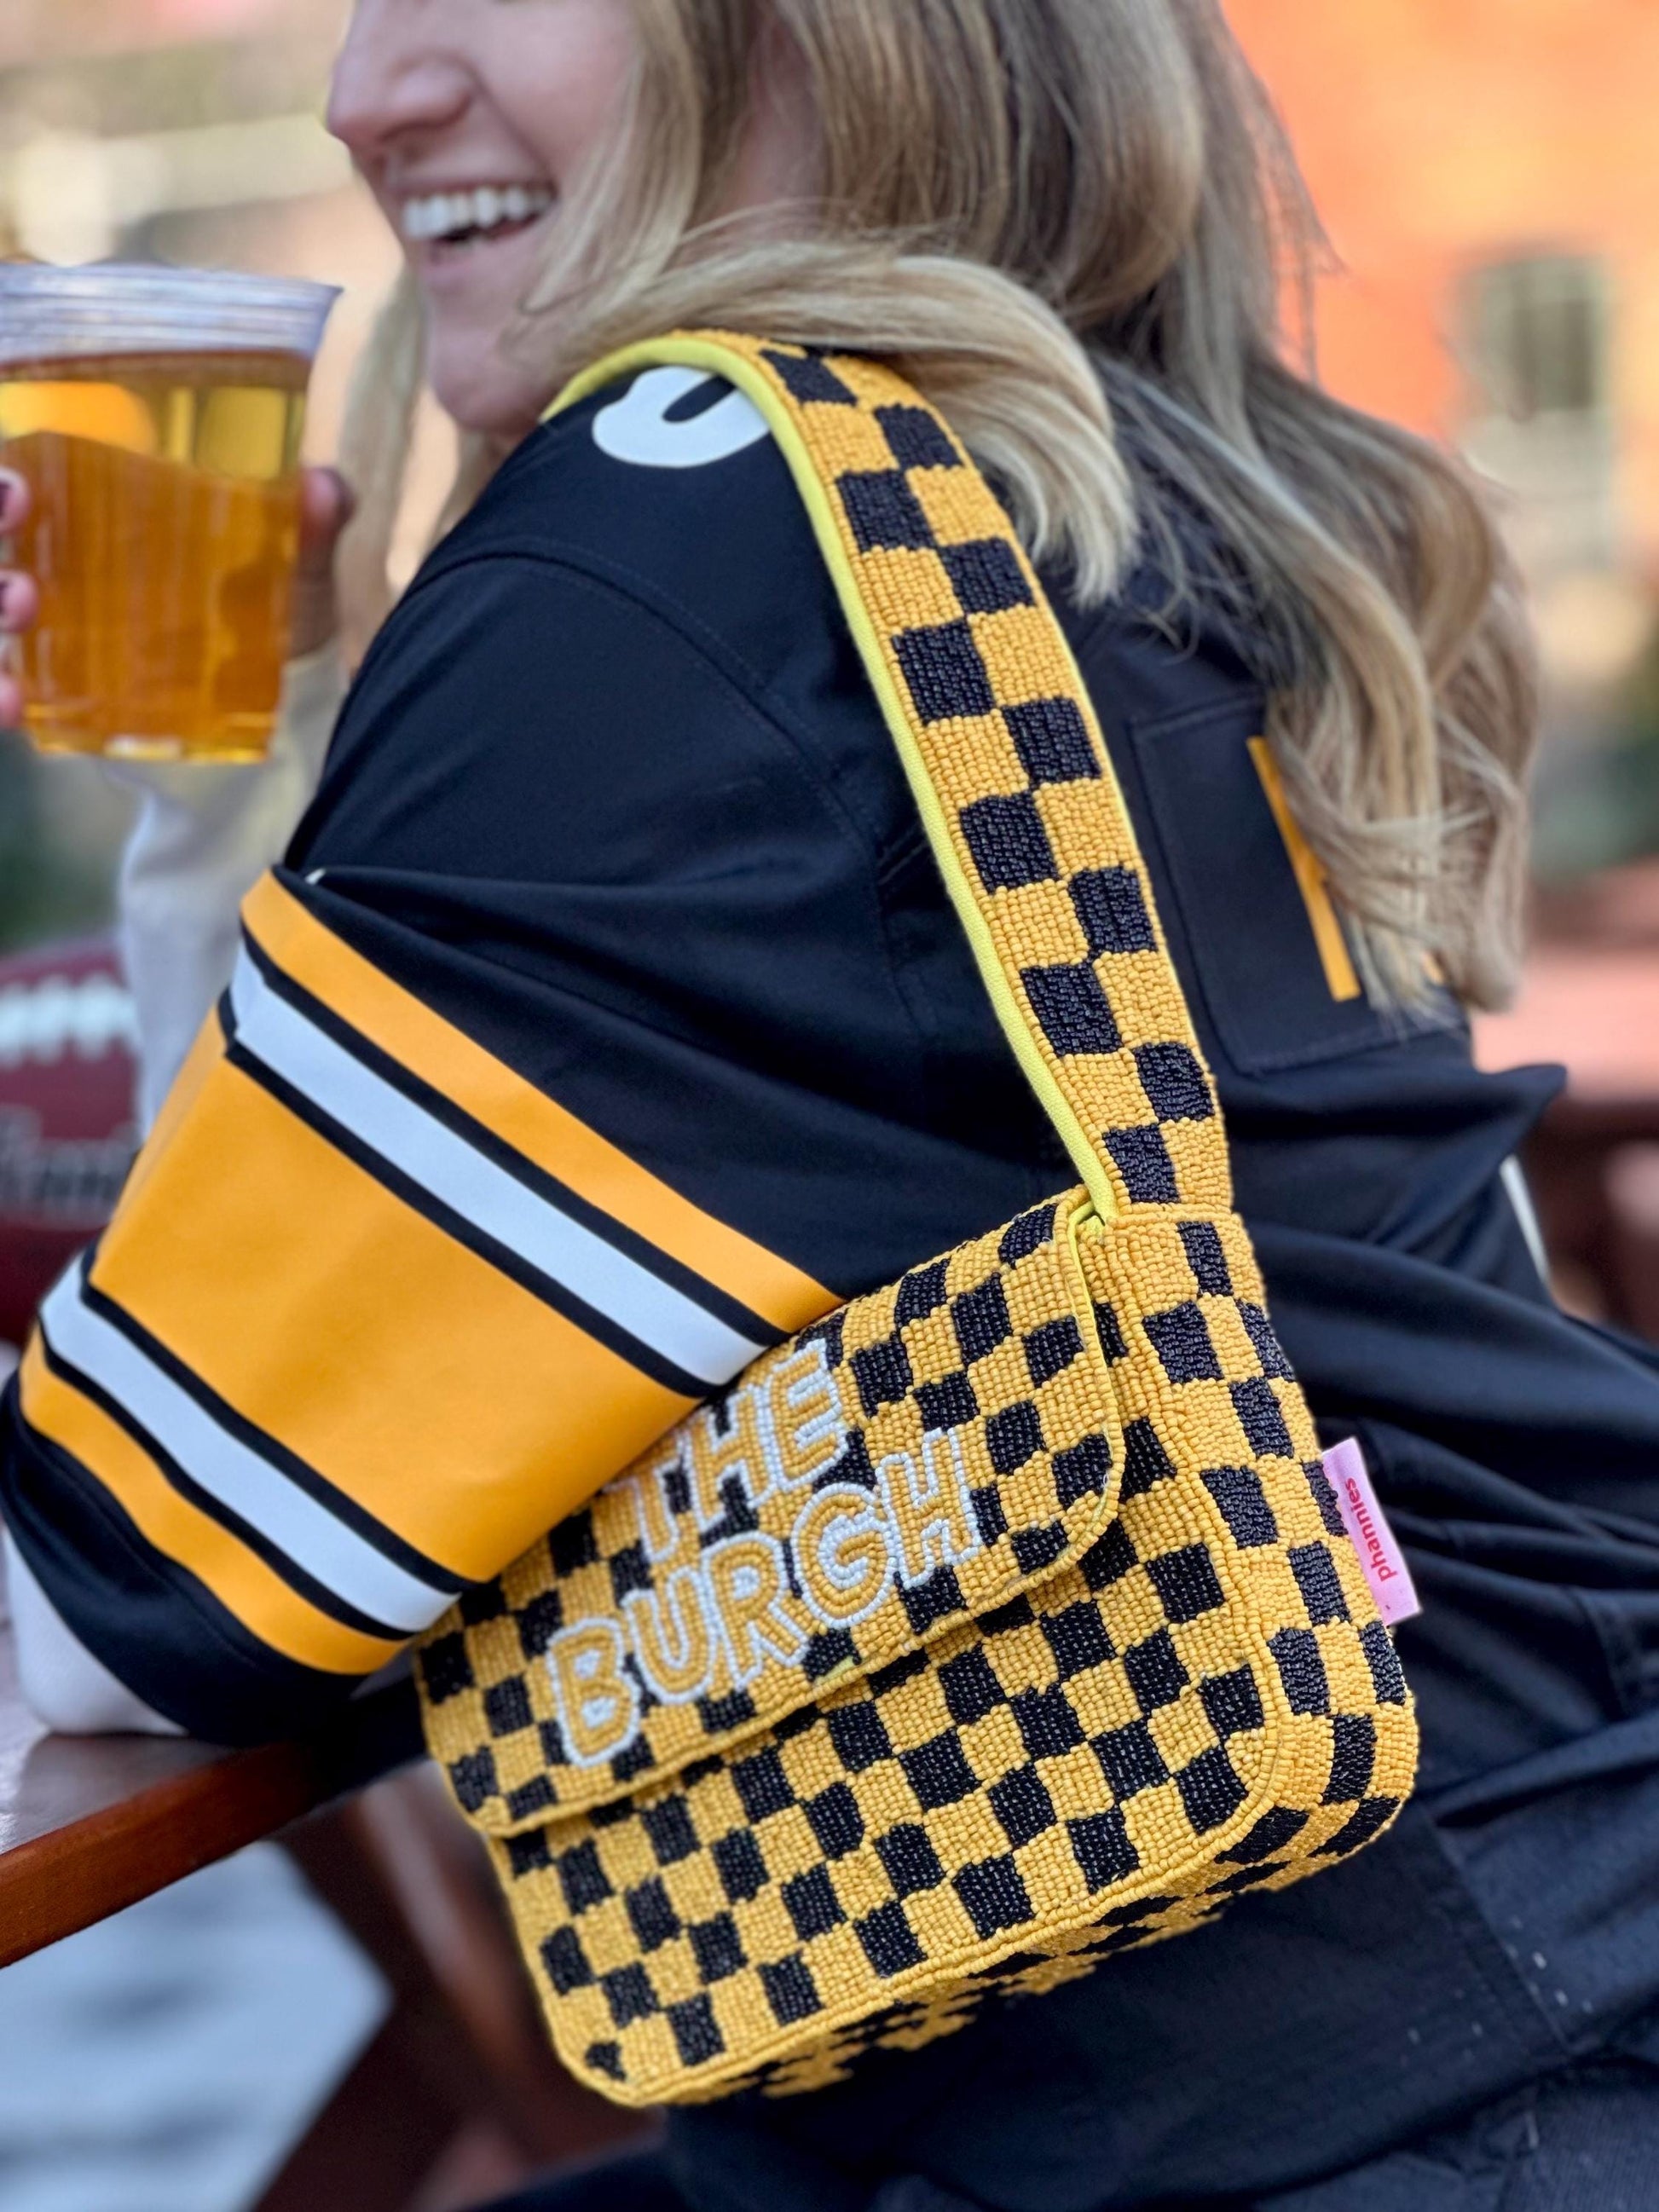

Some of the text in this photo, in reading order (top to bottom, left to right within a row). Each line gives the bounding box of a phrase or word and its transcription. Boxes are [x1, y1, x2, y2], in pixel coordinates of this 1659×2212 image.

[602, 1338, 849, 1562] THE
[1344, 1476, 1398, 1582] phannies
[546, 1427, 982, 1768] BURGH
